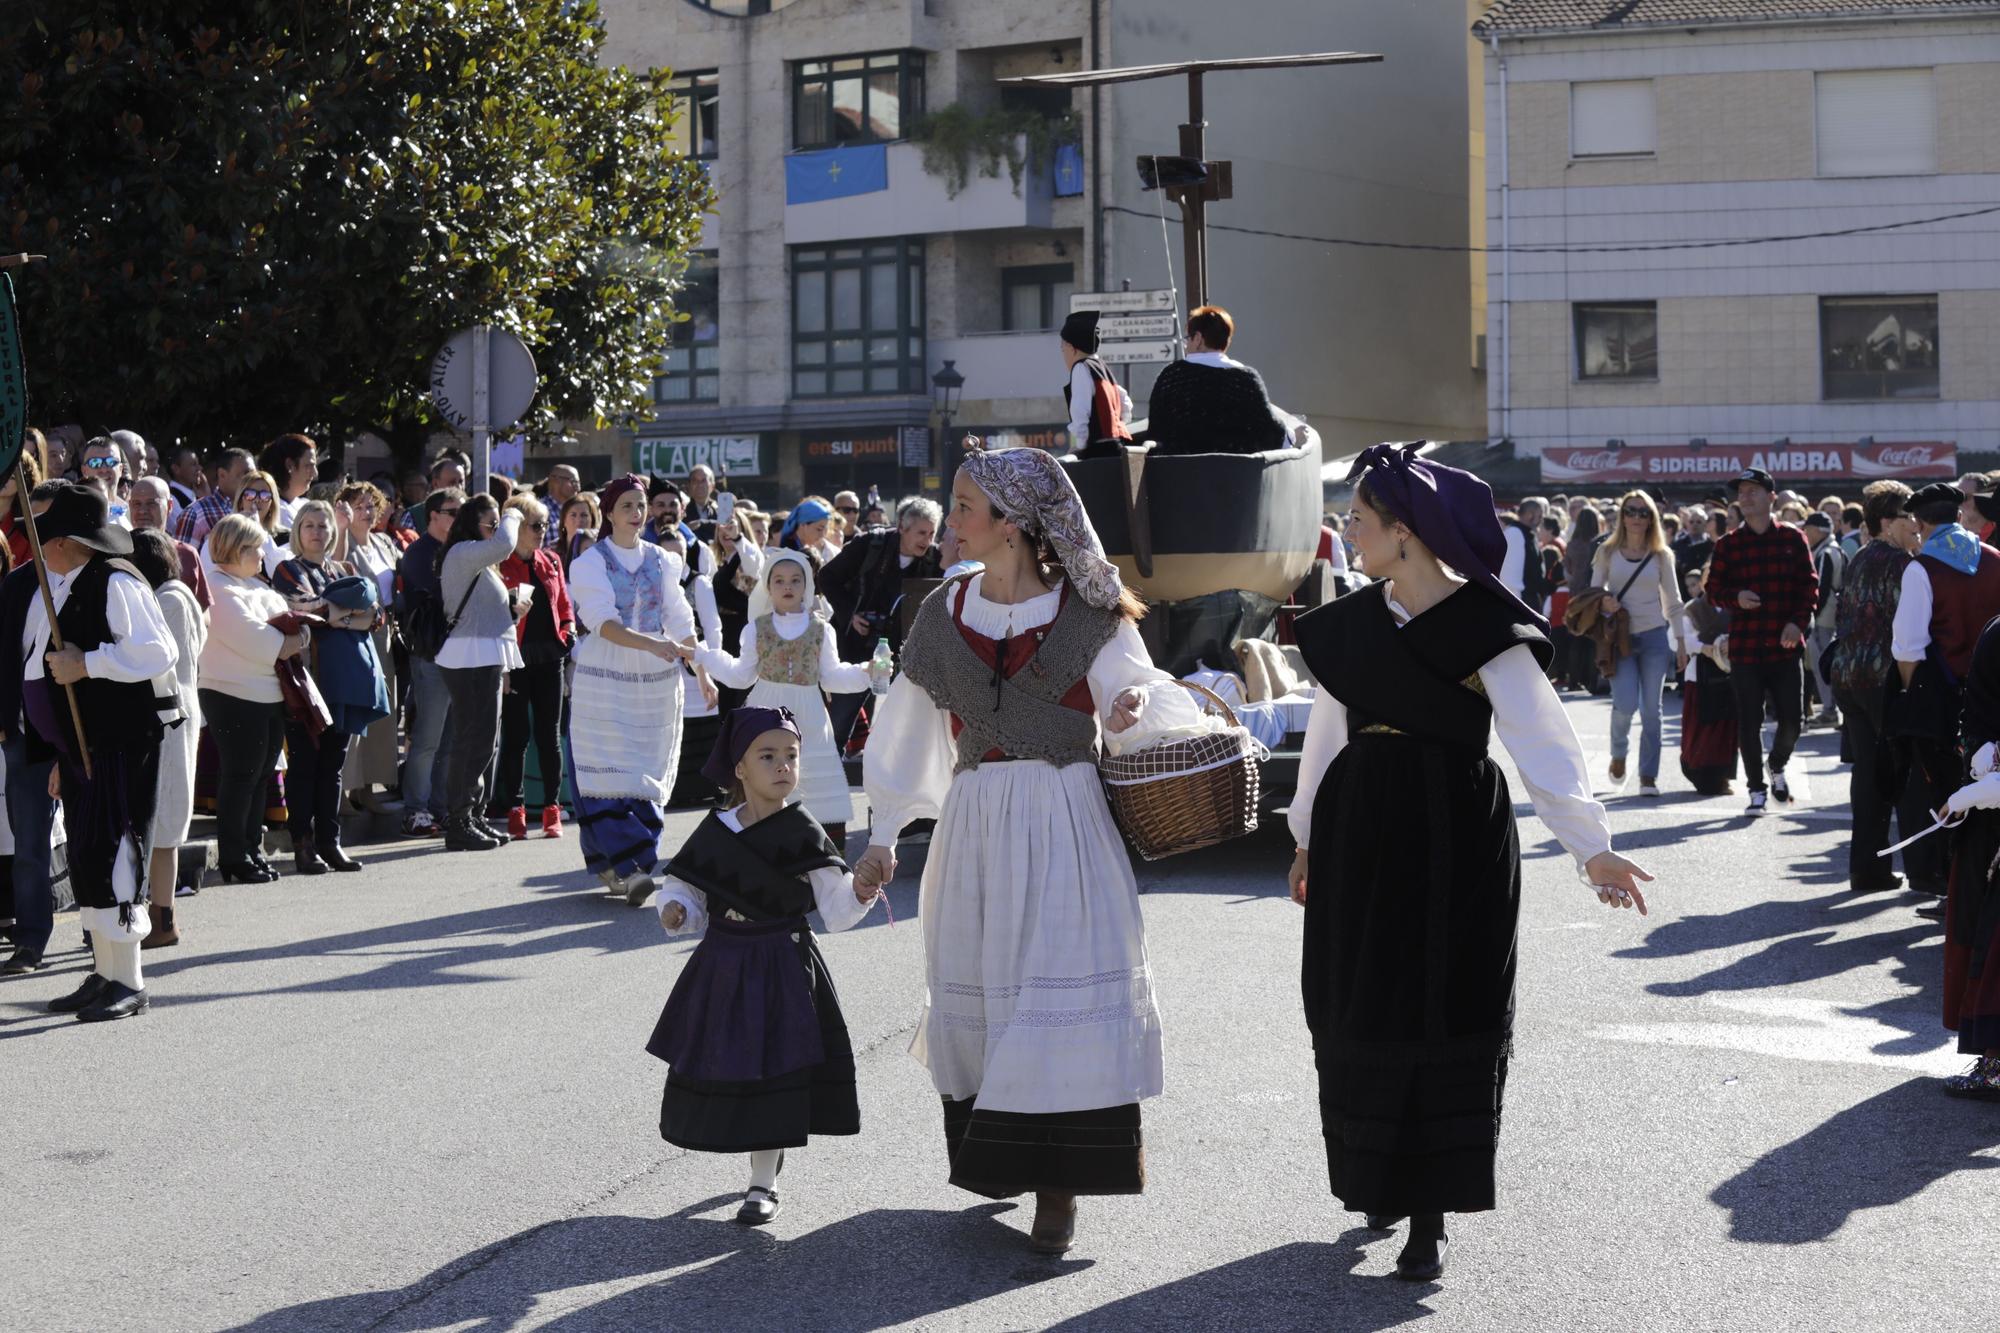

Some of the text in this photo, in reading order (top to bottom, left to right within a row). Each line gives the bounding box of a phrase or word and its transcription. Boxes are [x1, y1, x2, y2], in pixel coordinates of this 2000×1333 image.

[1124, 327, 1140, 335] SAN
[1143, 326, 1171, 335] ISIDRO
[433, 346, 467, 426] AYTO-ALLER
[808, 435, 898, 458] ensupunt
[640, 440, 664, 477] EL
[1649, 450, 1843, 473] SIDRERIA AMBRA
